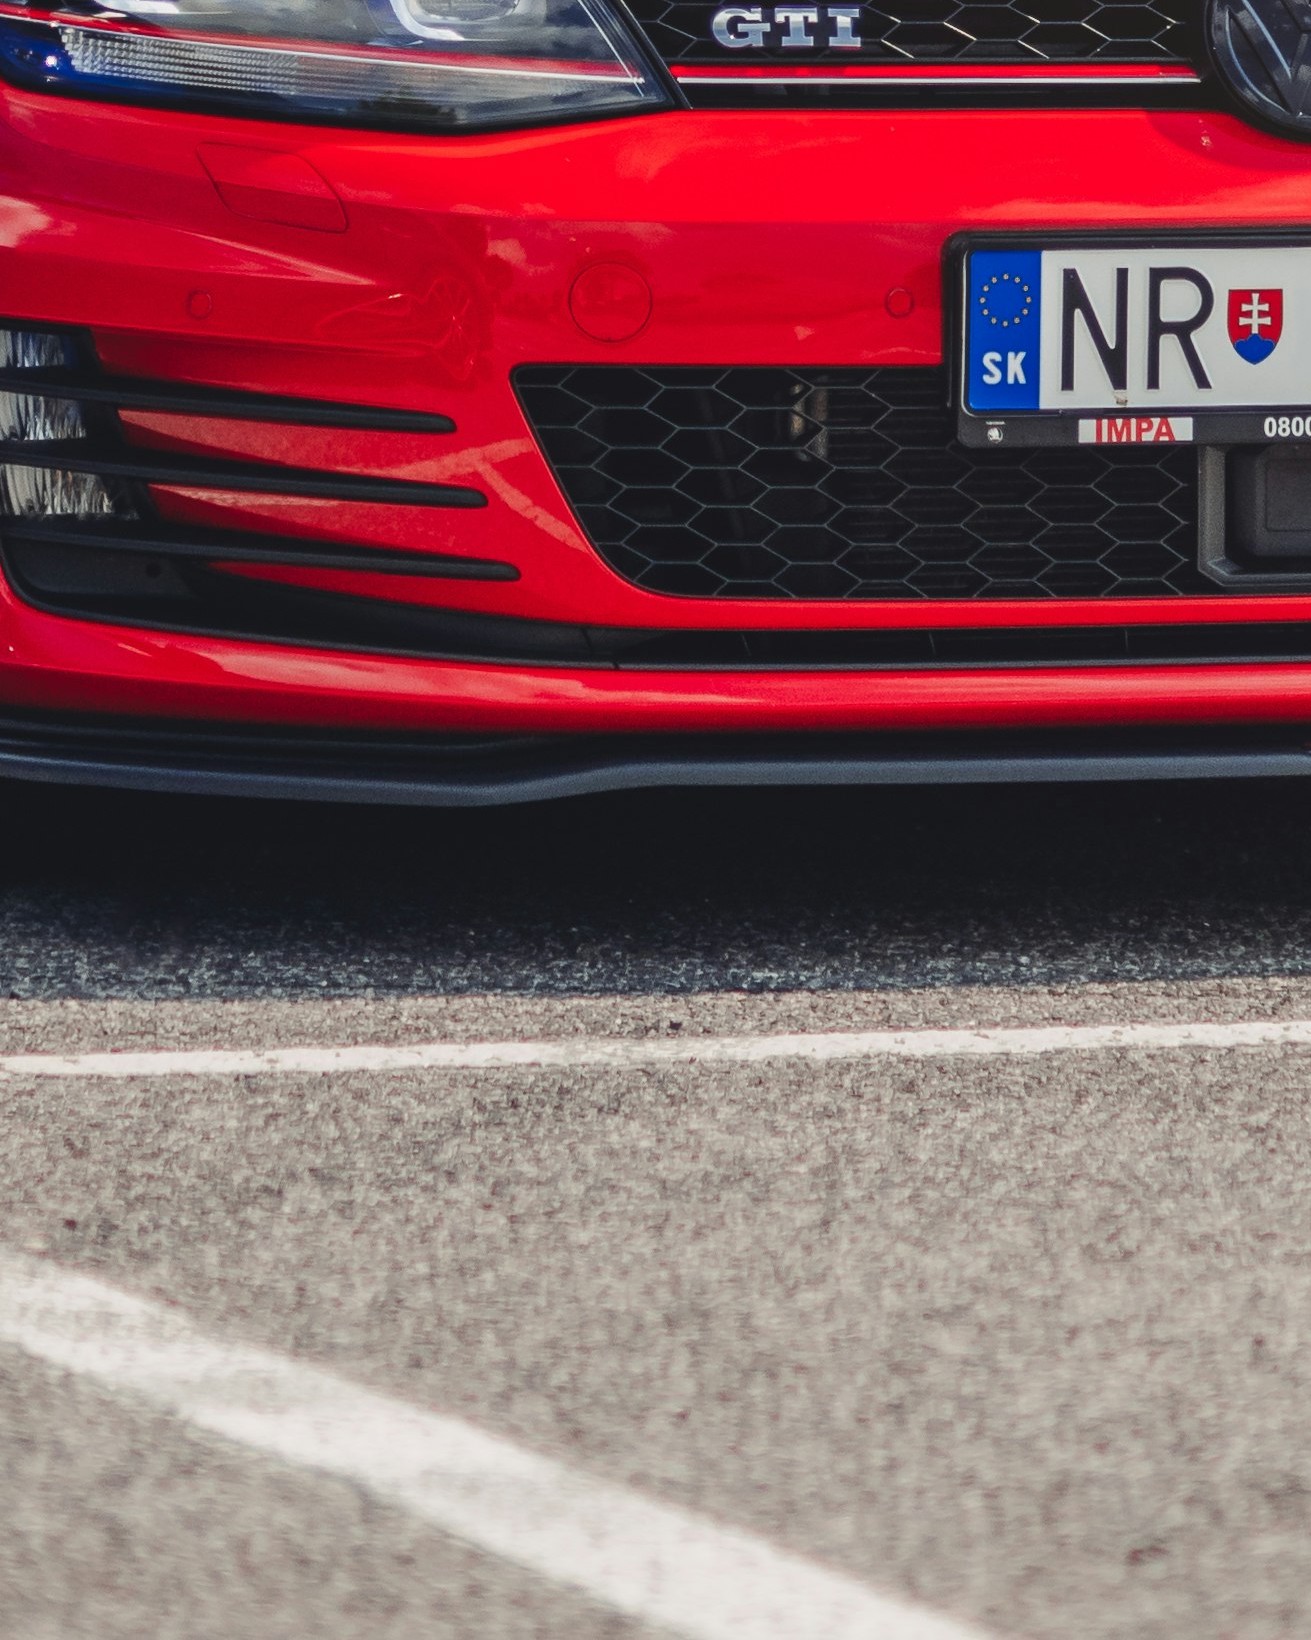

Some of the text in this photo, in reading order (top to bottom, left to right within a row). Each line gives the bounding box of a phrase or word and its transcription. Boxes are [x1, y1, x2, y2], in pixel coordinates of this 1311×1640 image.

[712, 7, 862, 49] GTI
[1061, 266, 1215, 391] NR
[982, 351, 1027, 385] SK
[1095, 416, 1176, 444] IMPA
